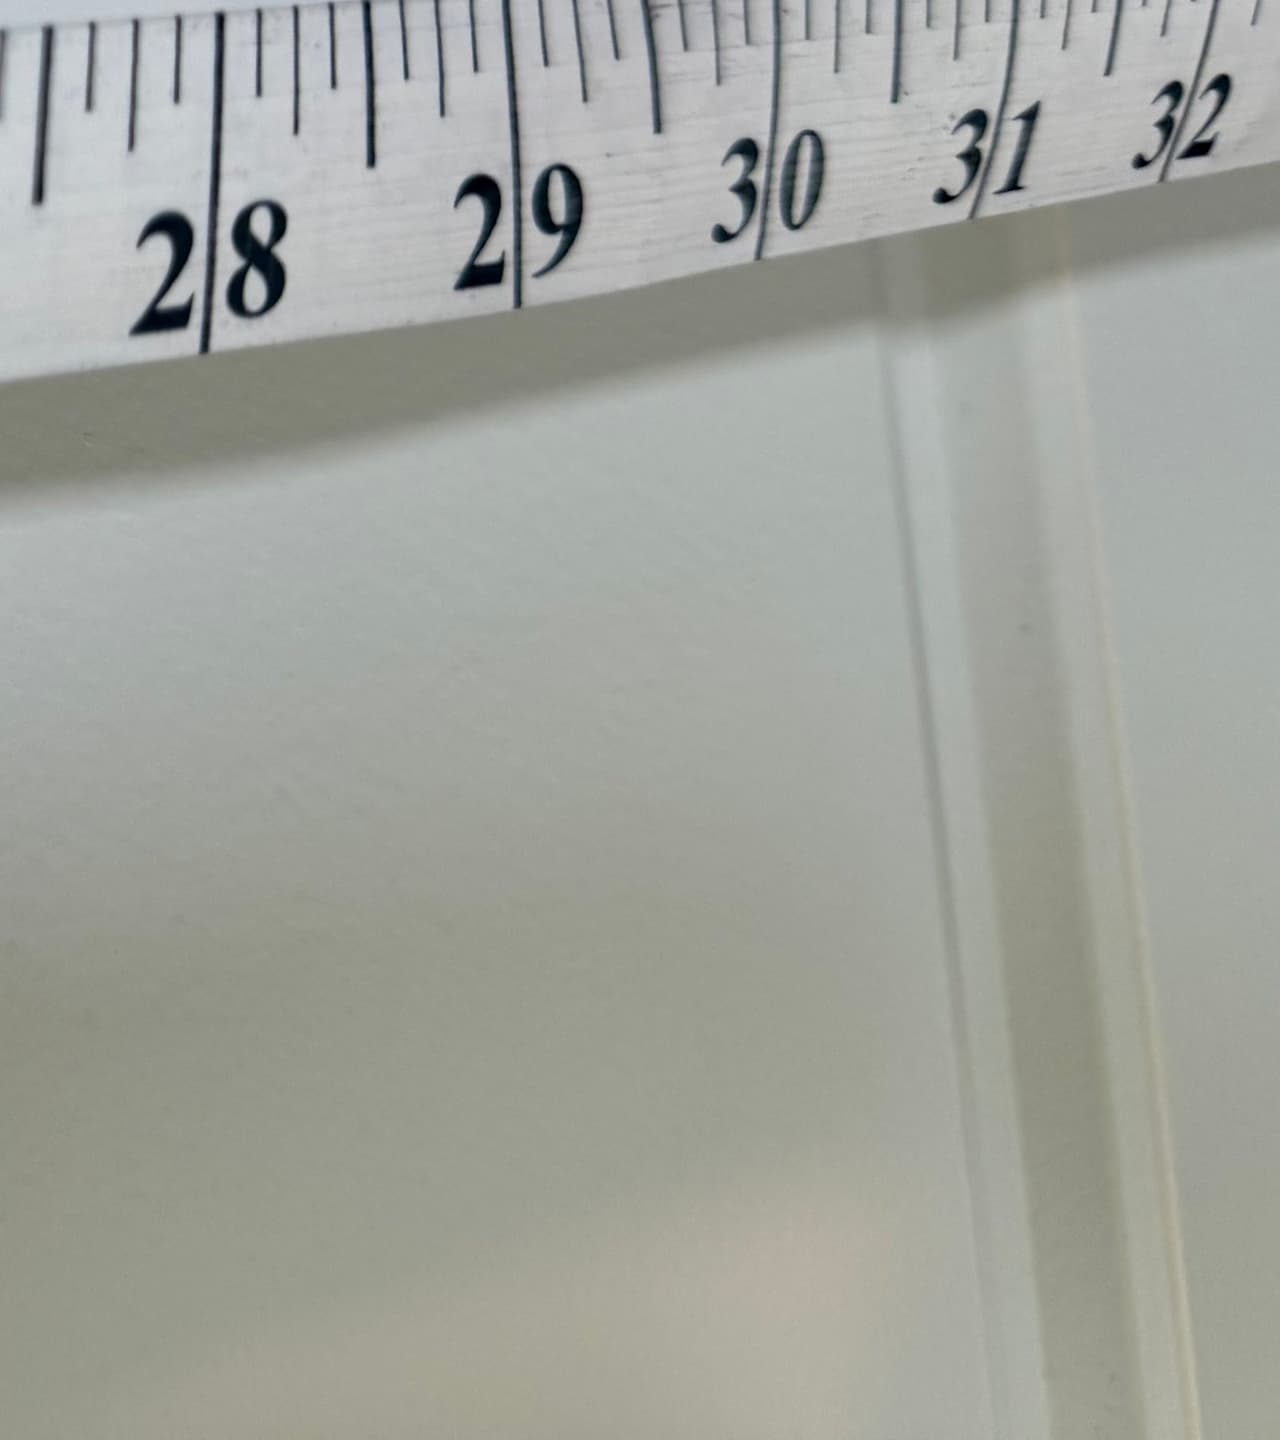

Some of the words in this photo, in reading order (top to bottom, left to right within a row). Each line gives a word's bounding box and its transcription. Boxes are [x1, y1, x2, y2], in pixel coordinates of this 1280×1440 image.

[129, 200, 288, 336] 28
[454, 163, 583, 290] 29
[711, 129, 825, 243] 30
[933, 100, 1041, 204] 31
[1131, 73, 1232, 169] 32
